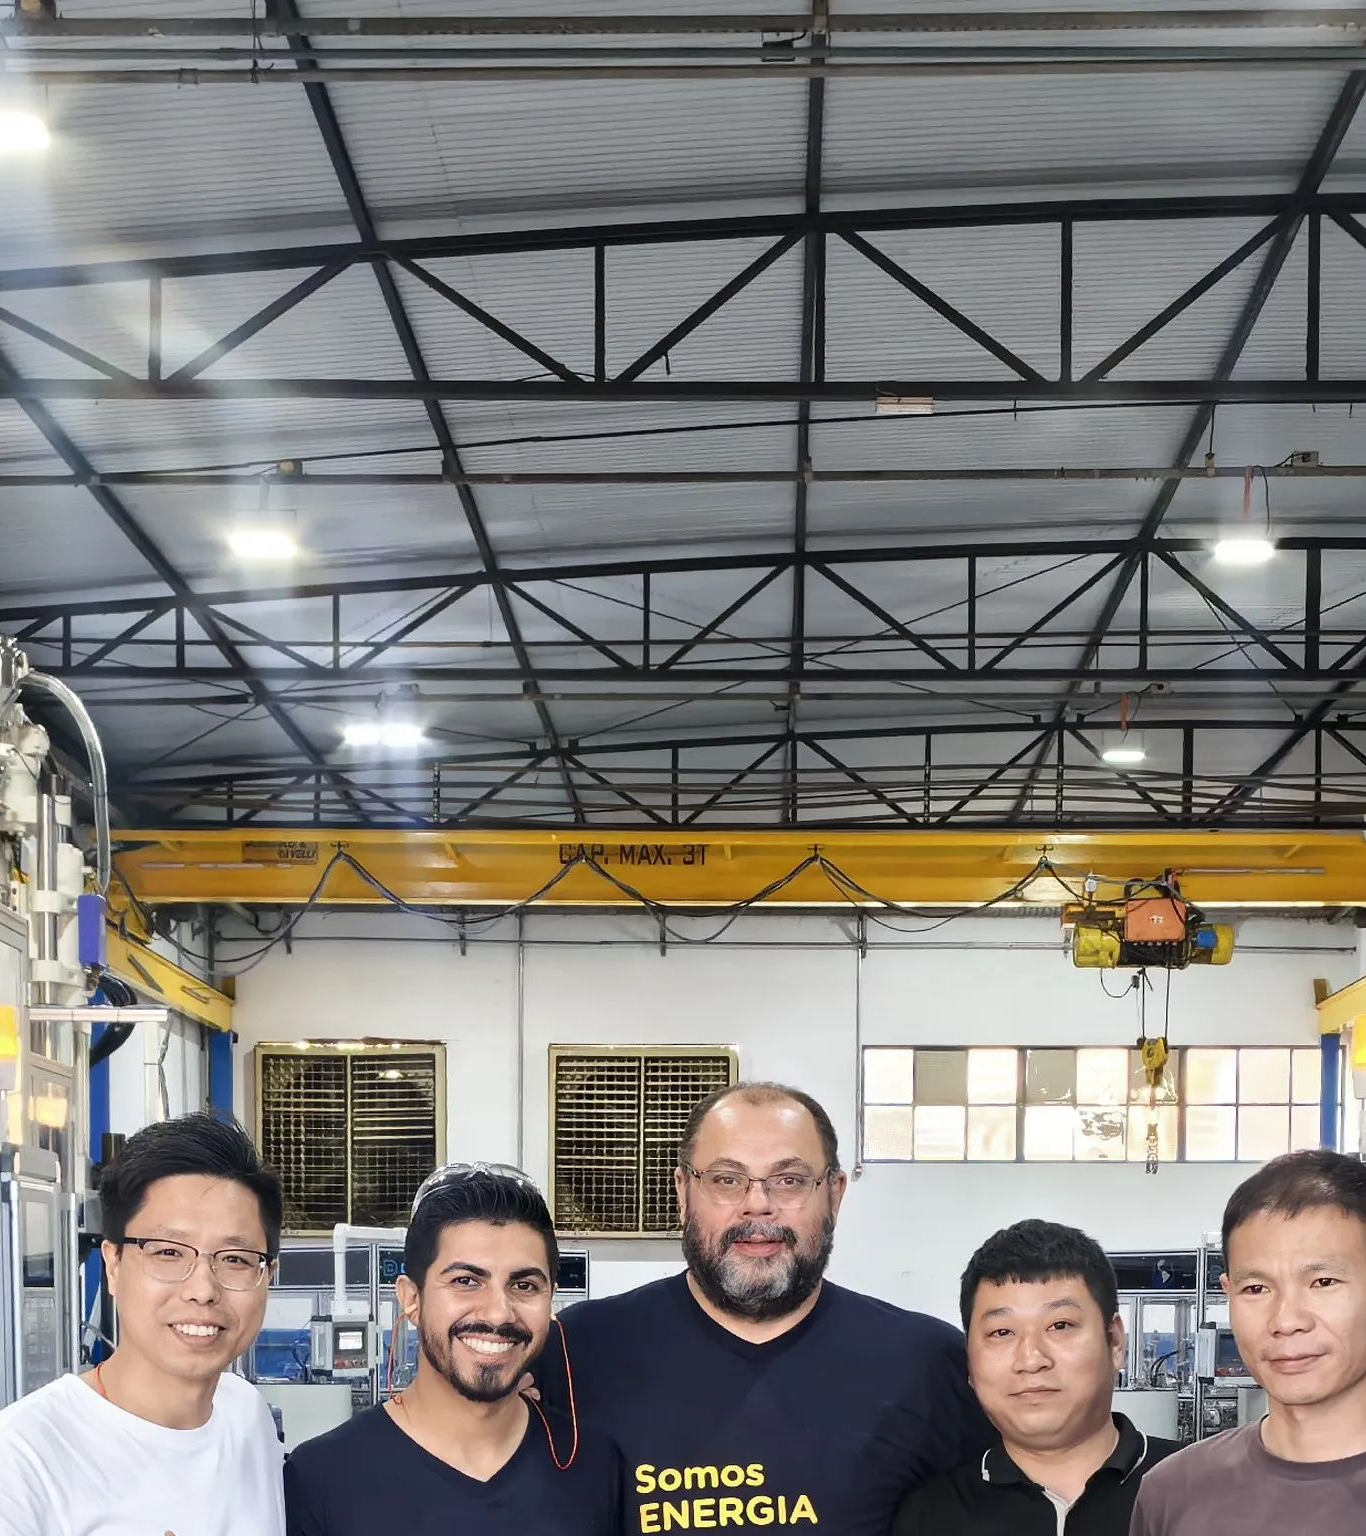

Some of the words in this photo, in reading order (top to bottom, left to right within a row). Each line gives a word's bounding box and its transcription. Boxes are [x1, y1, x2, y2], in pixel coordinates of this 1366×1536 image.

[619, 843, 673, 866] MAX.
[682, 843, 709, 866] 3T
[635, 1463, 765, 1494] Somos
[639, 1494, 819, 1534] ENERGIA
